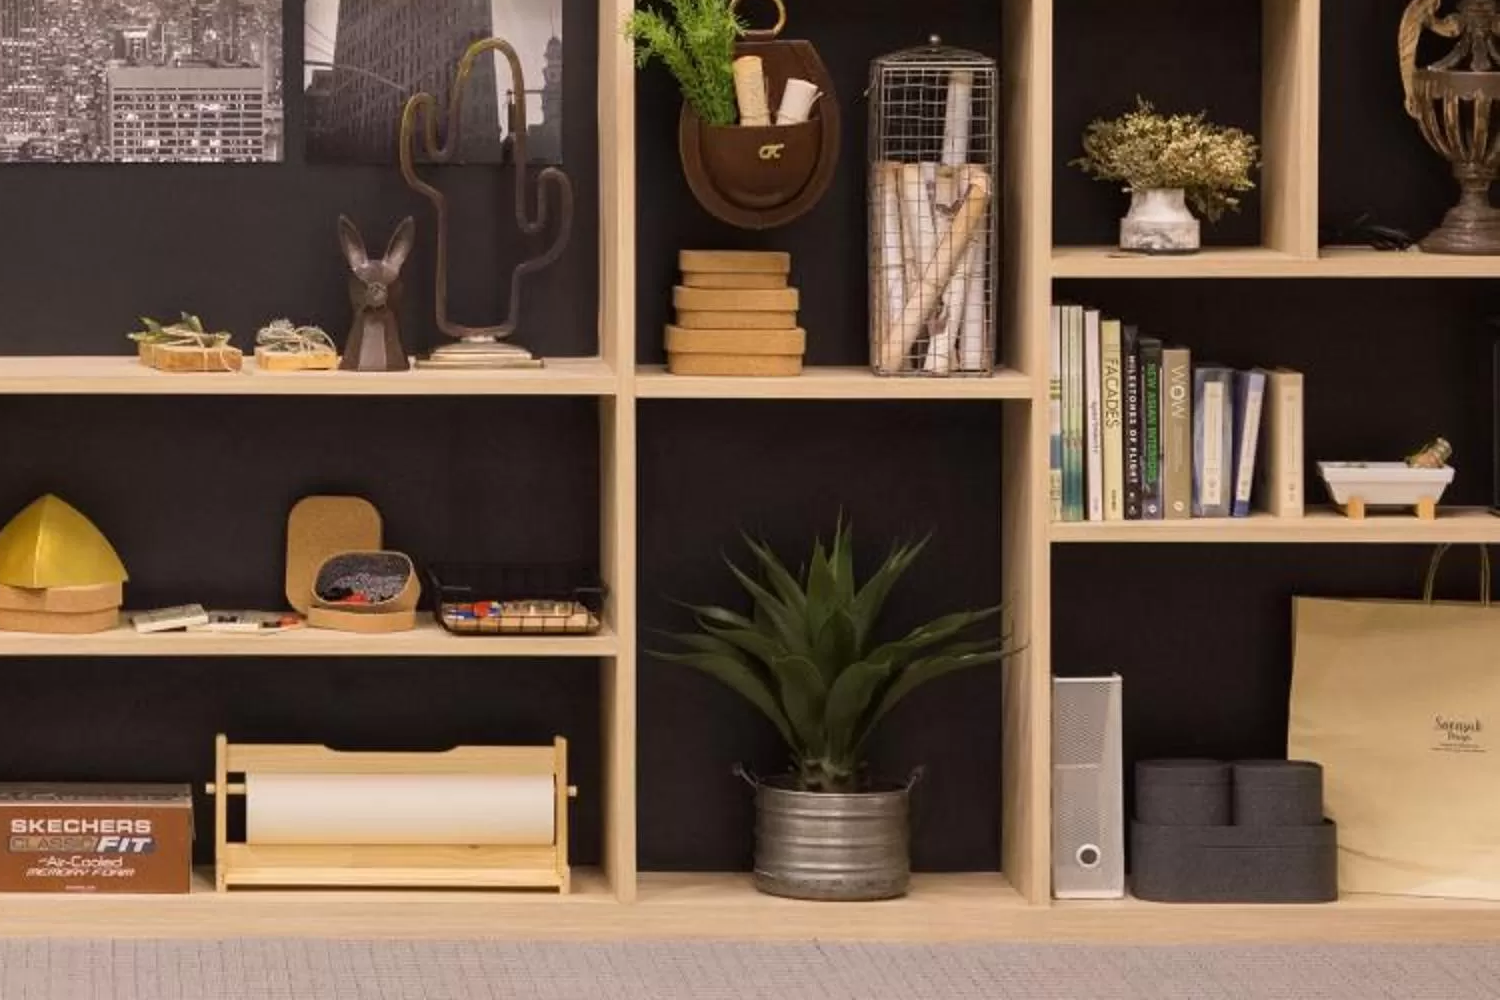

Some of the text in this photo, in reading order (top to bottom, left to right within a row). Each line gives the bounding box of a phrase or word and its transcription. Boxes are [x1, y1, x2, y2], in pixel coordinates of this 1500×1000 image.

[1146, 363, 1157, 389] NEW
[1170, 364, 1187, 419] WOW
[1128, 355, 1138, 484] MILESTONES OF FLIGHT
[10, 818, 152, 834] SKECHERS
[97, 835, 152, 853] FIT
